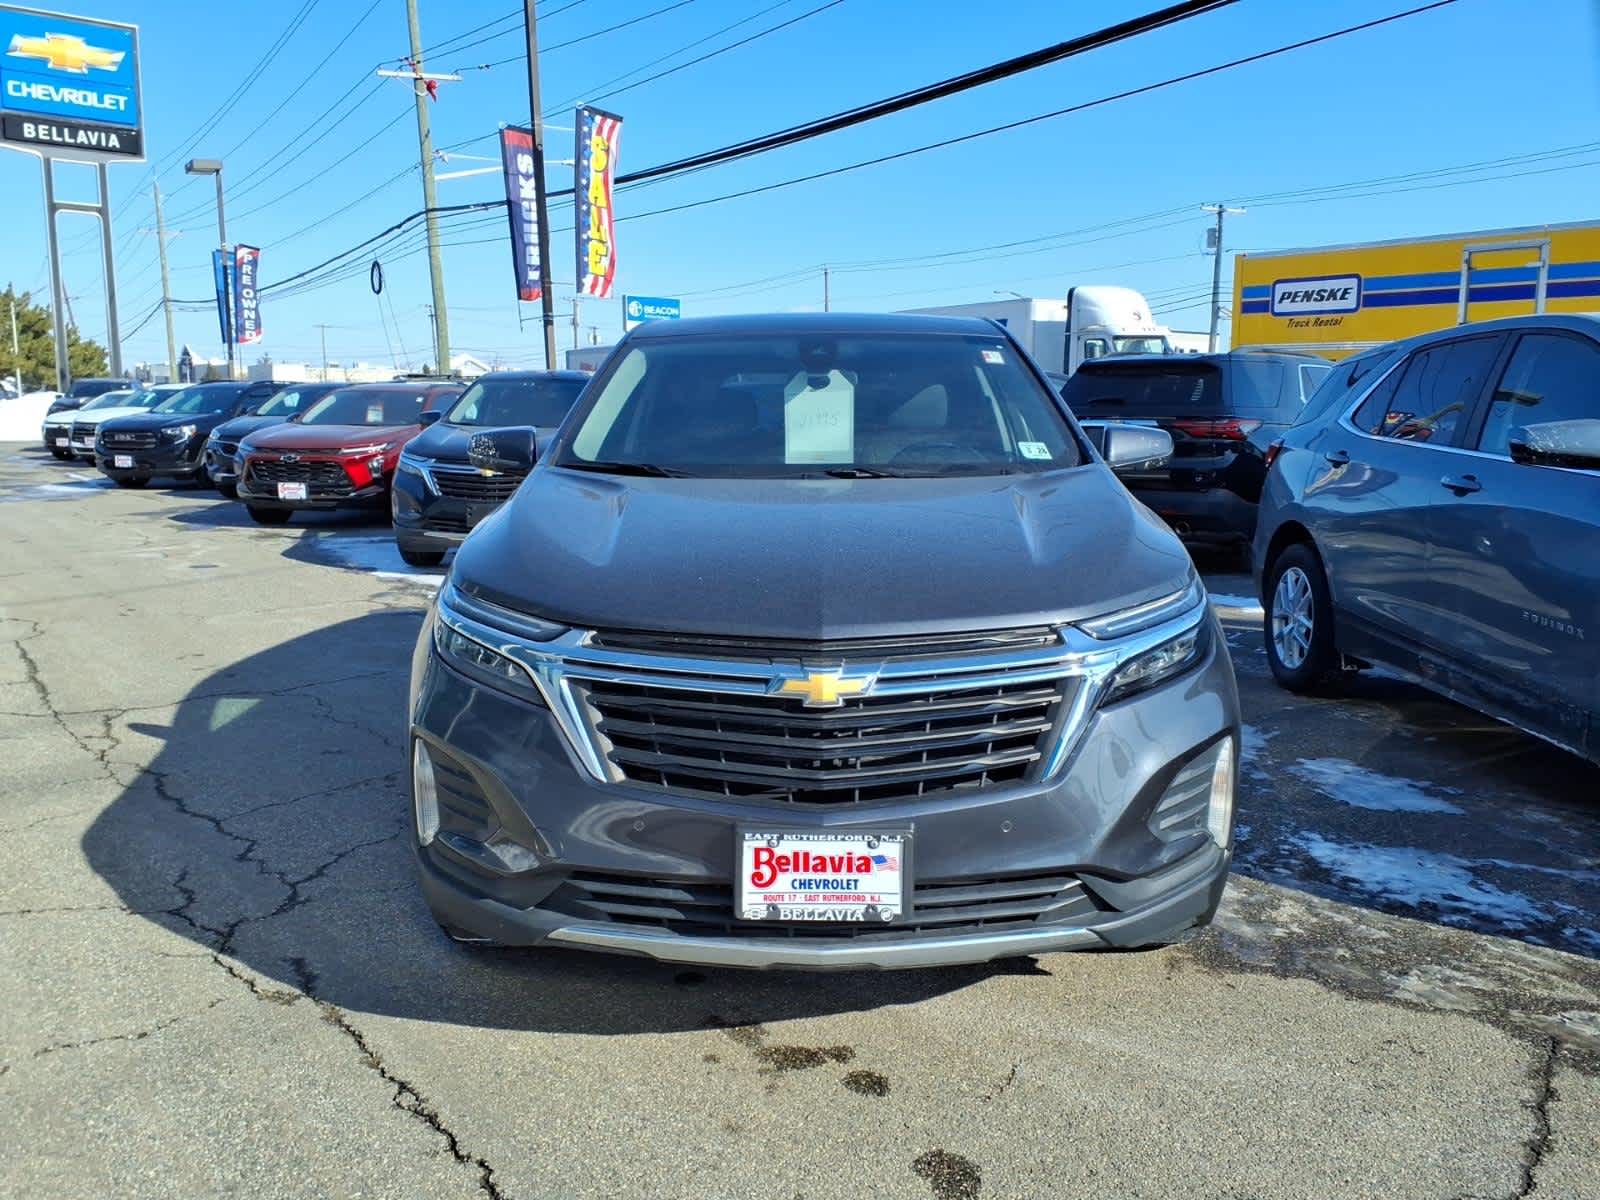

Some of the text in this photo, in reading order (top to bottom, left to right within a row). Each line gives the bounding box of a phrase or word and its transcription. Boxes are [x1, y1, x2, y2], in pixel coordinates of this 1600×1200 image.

[6, 79, 128, 111] CHEVROLET
[23, 122, 120, 149] BELLAVIA
[241, 254, 257, 339] PRE OWNED
[1277, 287, 1354, 305] PENSKE
[643, 304, 679, 315] BEACON
[1286, 316, 1345, 328] Truck Rental
[744, 833, 779, 841] EAST
[751, 847, 871, 888] Bellavia
[791, 878, 859, 890] CHEVROLET
[763, 894, 785, 903] ROUTE
[788, 894, 797, 903] 17
[804, 894, 820, 903] EAST
[780, 907, 864, 921] BELLAVIA
